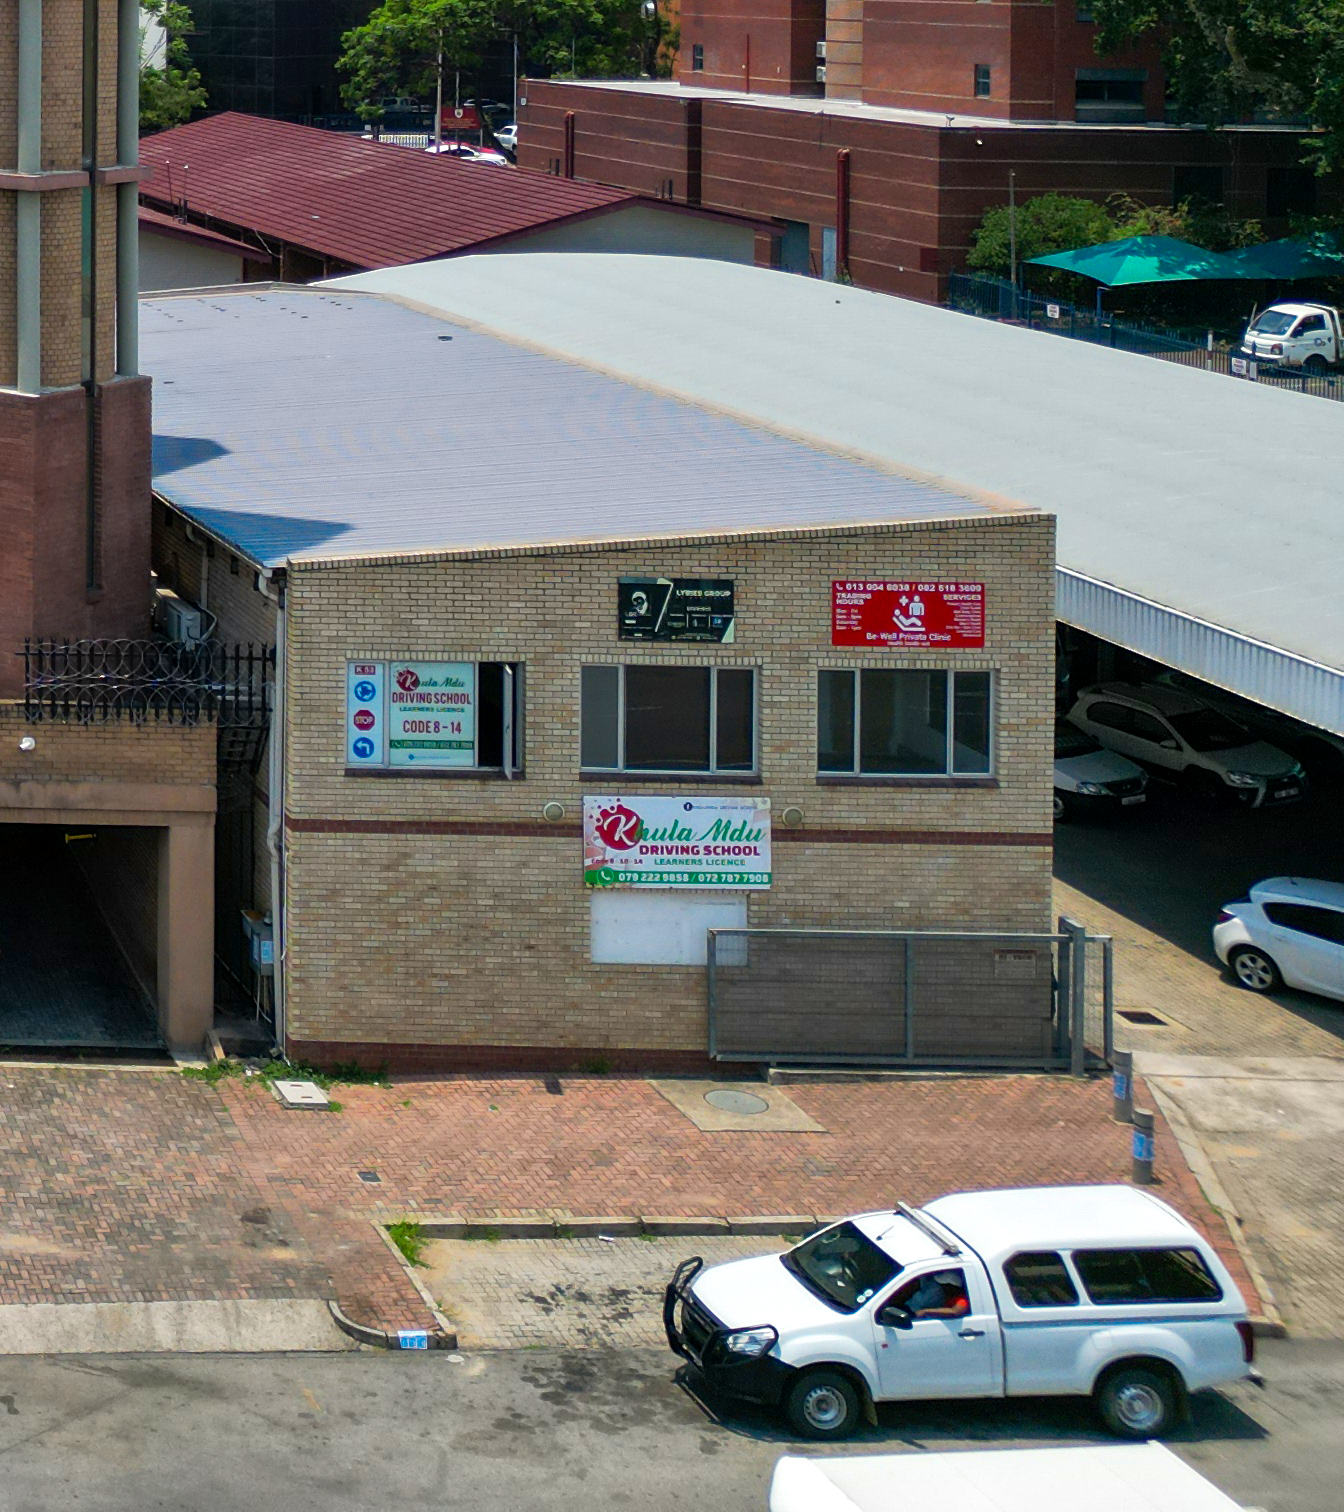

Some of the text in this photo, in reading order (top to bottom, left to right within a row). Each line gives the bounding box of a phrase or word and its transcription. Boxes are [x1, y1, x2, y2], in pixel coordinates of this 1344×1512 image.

[899, 633, 927, 641] Private
[929, 633, 951, 641] Clinic
[392, 692, 471, 705] DRIVING SCHOOL
[355, 716, 374, 724] STOP
[403, 720, 431, 733] CODE
[433, 720, 440, 733] 8
[450, 721, 461, 734] 14
[603, 814, 767, 846] Khula Mdu
[639, 844, 761, 856] DRIVING SCHOOL
[654, 858, 703, 866] LEARNERS
[640, 873, 661, 882] 222
